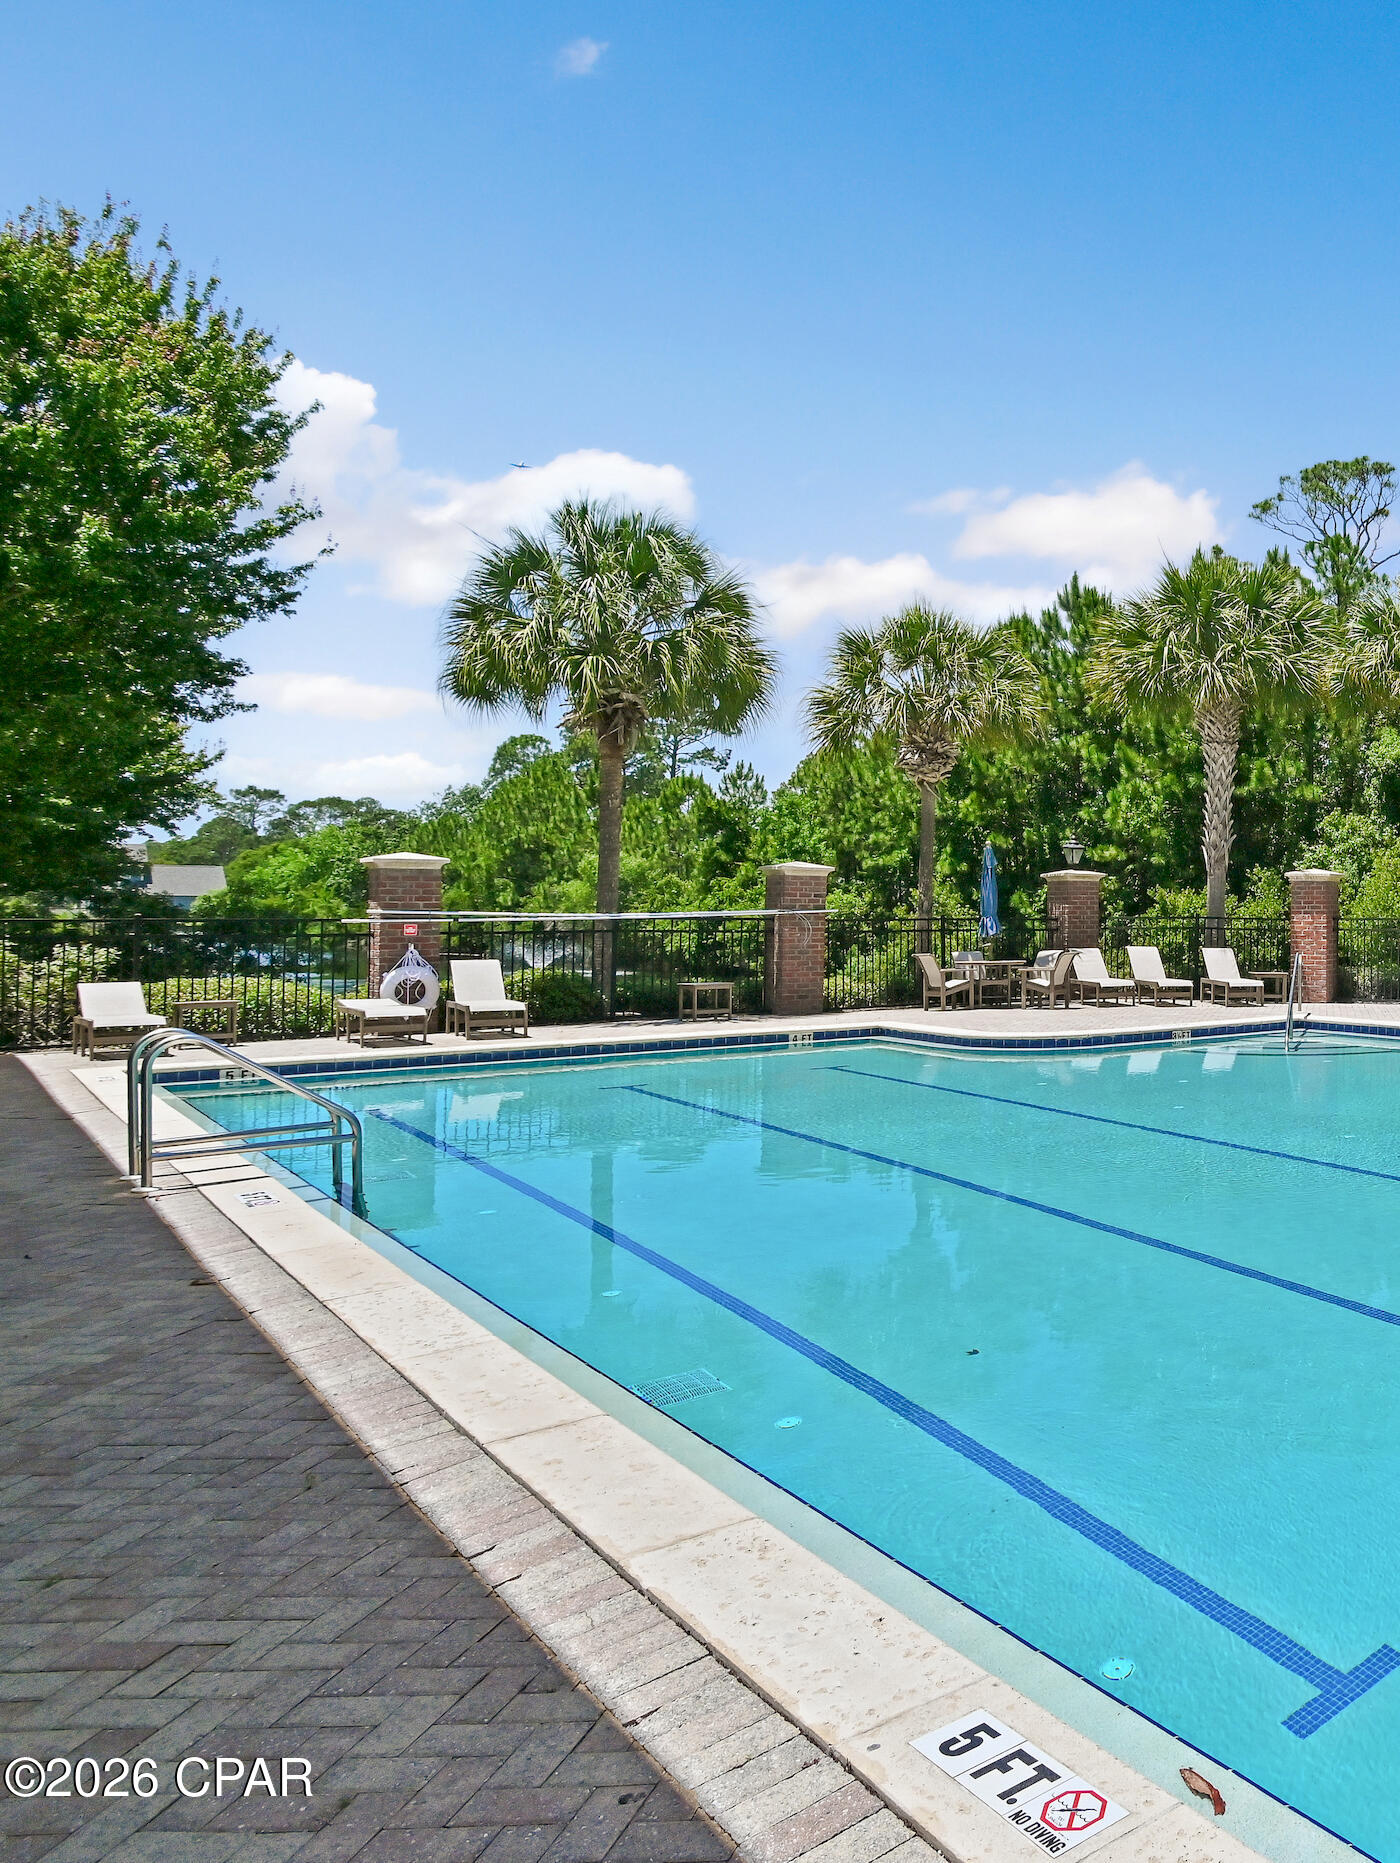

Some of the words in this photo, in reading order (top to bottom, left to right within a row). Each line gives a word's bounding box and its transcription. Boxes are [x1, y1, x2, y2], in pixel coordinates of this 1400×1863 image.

[226, 1071, 234, 1079] 5
[938, 1722, 1002, 1757] 5
[969, 1748, 1062, 1805] FT.
[1008, 1809, 1031, 1825] NO
[1023, 1821, 1067, 1854] DIVING
